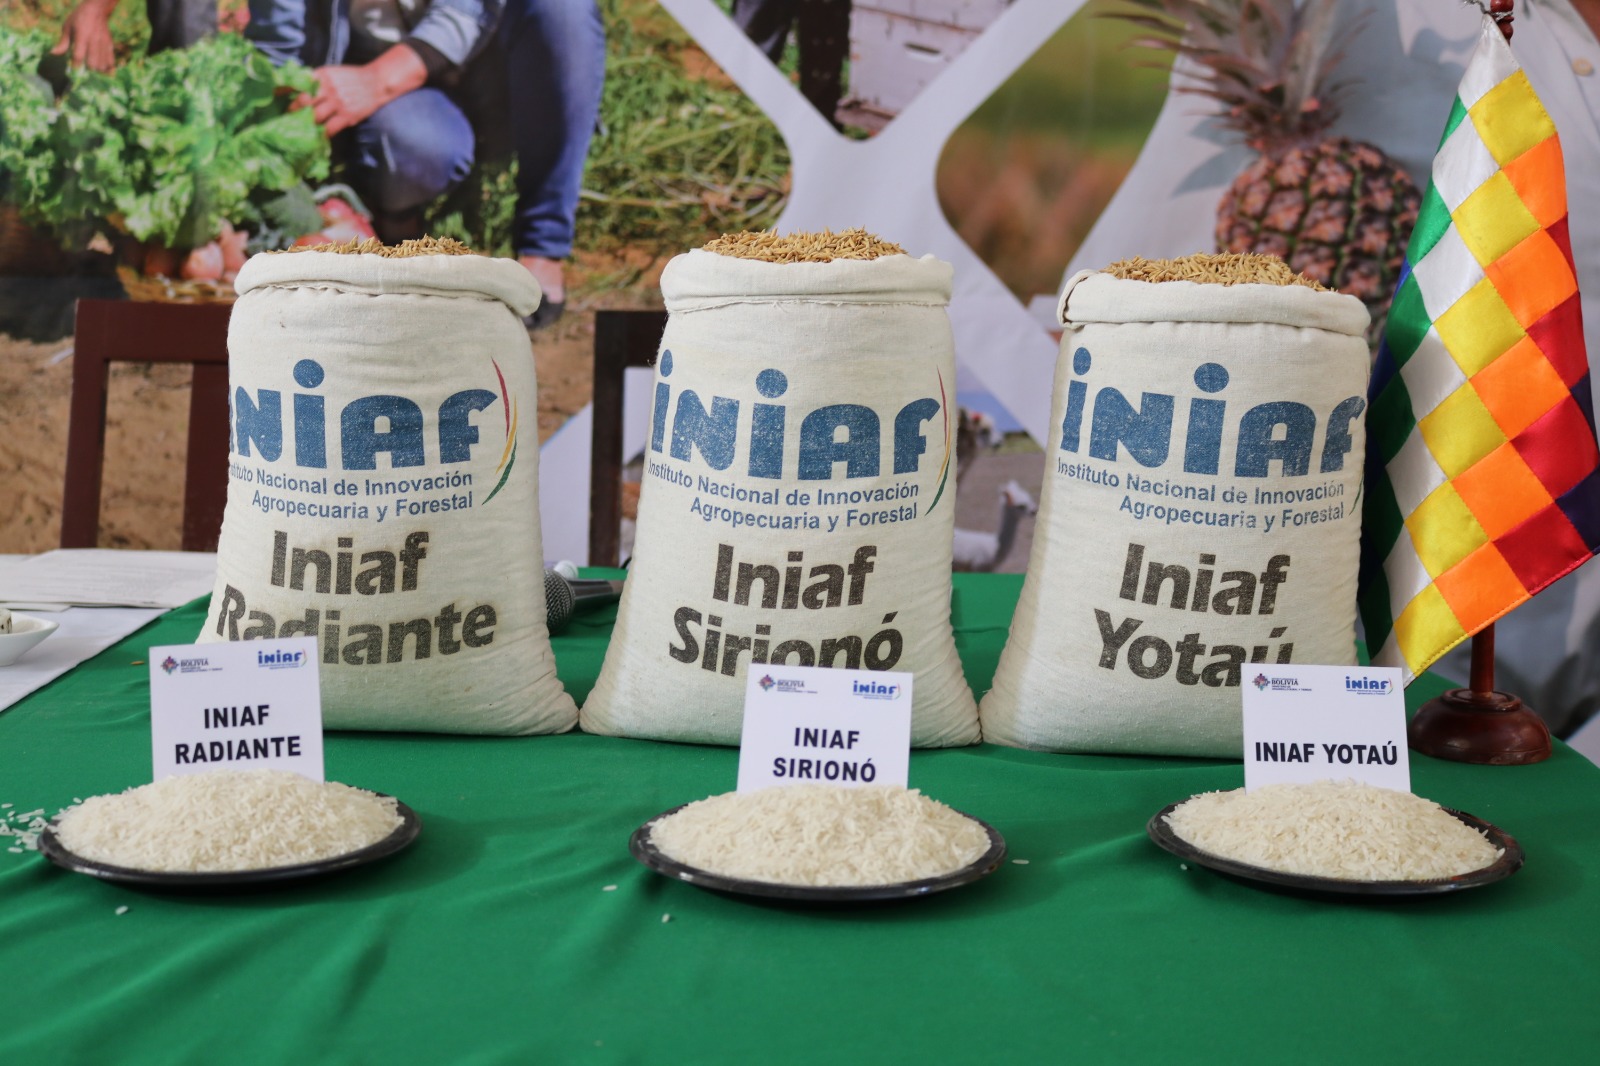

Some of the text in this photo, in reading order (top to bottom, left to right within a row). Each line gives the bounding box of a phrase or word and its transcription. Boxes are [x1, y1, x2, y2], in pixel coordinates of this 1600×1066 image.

[256, 469, 327, 495] Nacional
[334, 478, 359, 496] de
[365, 470, 473, 497] Innovación
[648, 458, 919, 506] Instituto Nacional de Innovación
[1058, 457, 1344, 505] Instituto Nacional de Innovación
[252, 490, 473, 522] Agropecuaria y Forestal
[690, 497, 917, 532] Agropecuaria y Forestal
[1119, 495, 1344, 533] Agropecuaria y Forestal
[270, 530, 429, 595] Iniaf
[713, 543, 877, 610] Iniaf
[1119, 543, 1291, 616] Iniaf
[217, 584, 497, 666] Radiante
[669, 606, 903, 677] Sirionó
[1093, 608, 1294, 688] Yotaú
[1271, 678, 1299, 686] BOLIVIA
[204, 704, 270, 729] INIAF
[175, 735, 301, 765] RADIANTE
[794, 727, 860, 750] INIAF
[1255, 741, 1398, 766] INIAF YOTAÚ
[773, 758, 876, 783] SIRIONÓ
